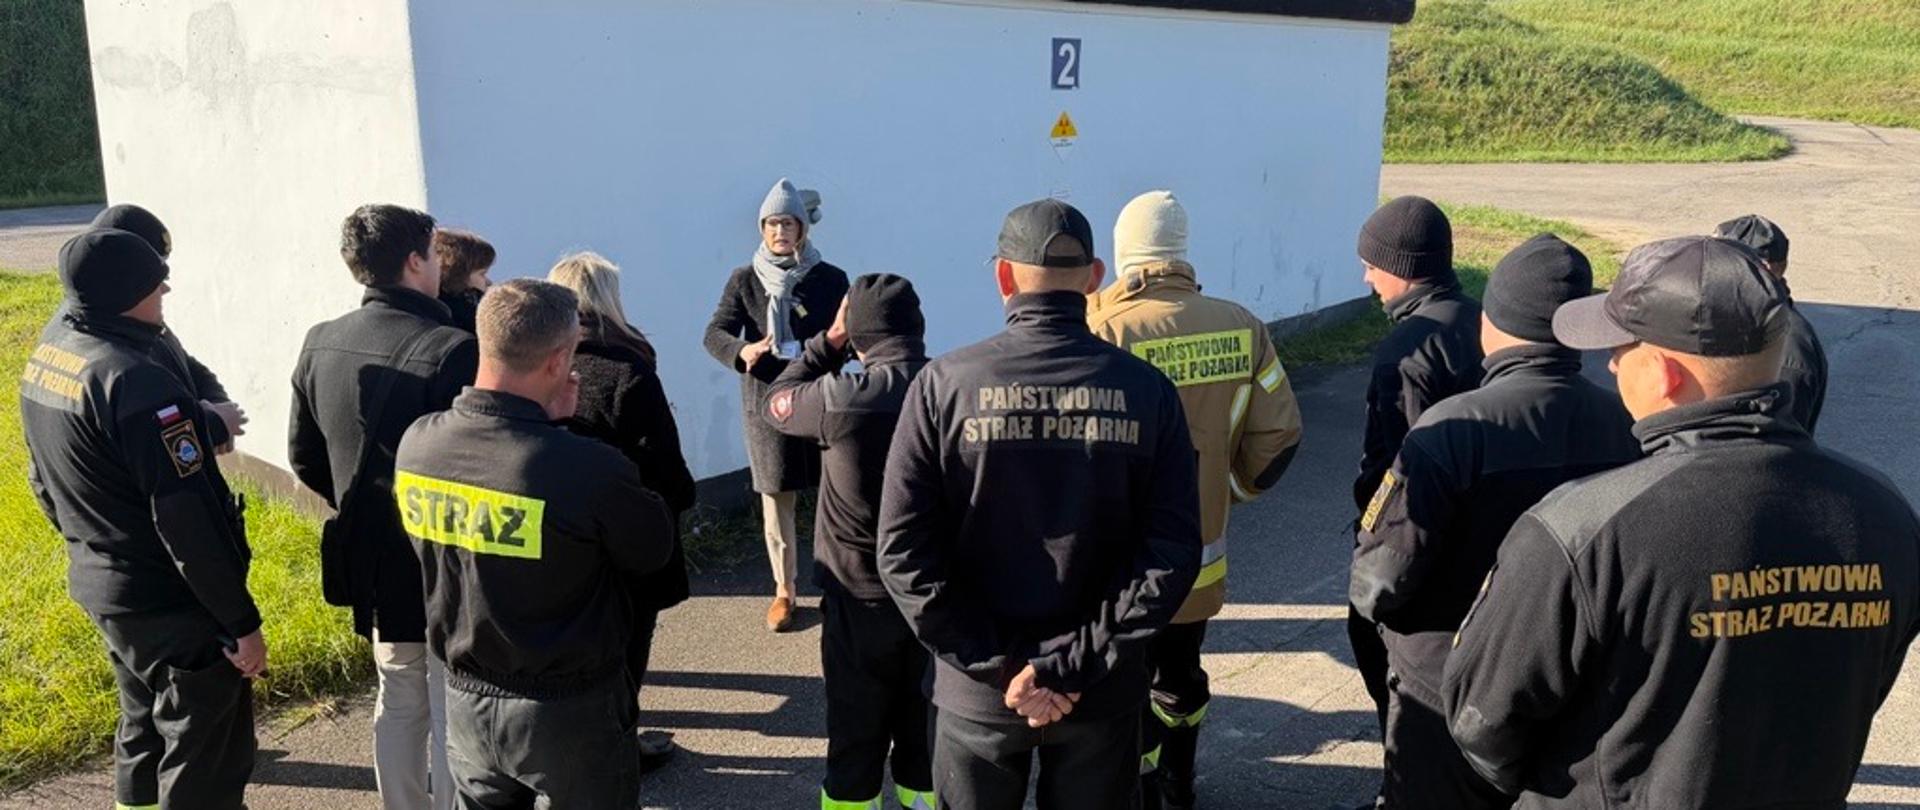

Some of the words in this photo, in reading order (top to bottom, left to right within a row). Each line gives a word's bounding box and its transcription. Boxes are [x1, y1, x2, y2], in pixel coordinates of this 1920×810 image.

[1057, 42, 1076, 86] 2
[1145, 336, 1241, 363] PAŃSTWOWA
[979, 381, 1127, 412] PAŃSTWOWA
[964, 415, 1034, 443] STRAŻ
[1042, 415, 1140, 445] POŻARNA
[1710, 563, 1883, 602] PAŃSTWOWA
